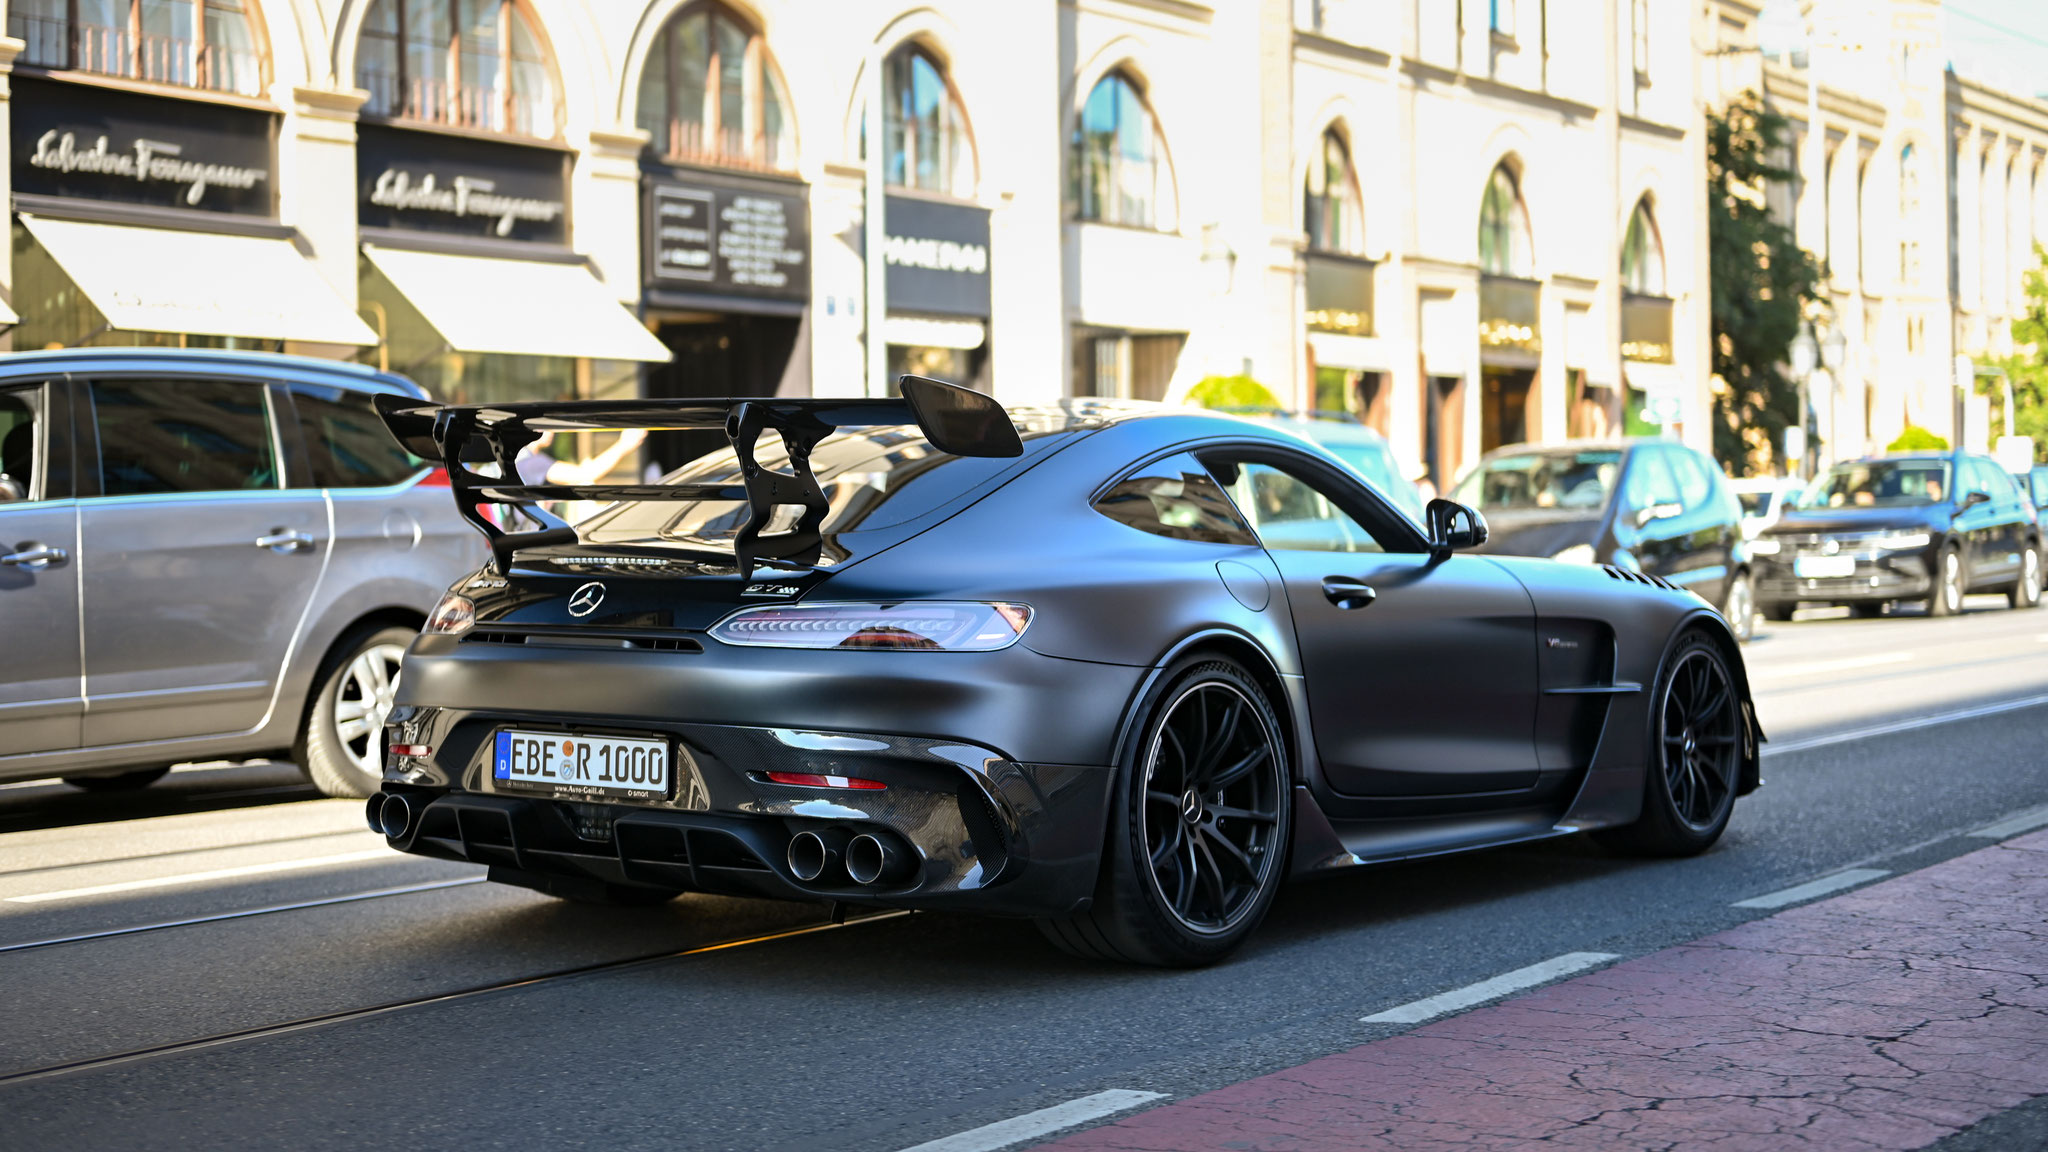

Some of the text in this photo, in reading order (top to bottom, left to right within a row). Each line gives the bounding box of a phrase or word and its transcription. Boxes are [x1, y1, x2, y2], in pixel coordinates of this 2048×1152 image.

[31, 129, 267, 206] Salvatore Ferragamo
[371, 168, 564, 237] Salvatore Ferragamo
[500, 738, 663, 785] D EBE R 1000
